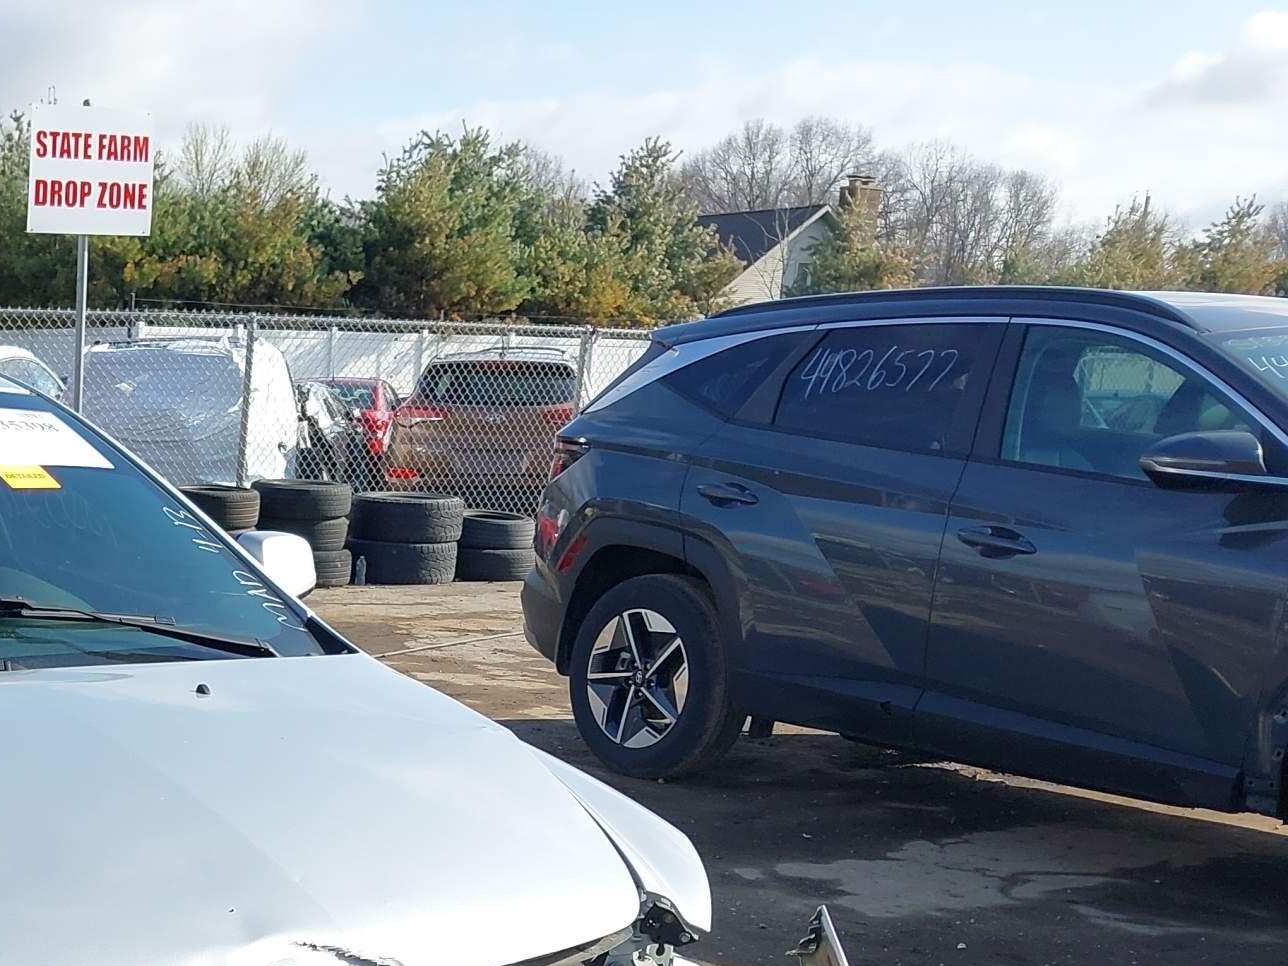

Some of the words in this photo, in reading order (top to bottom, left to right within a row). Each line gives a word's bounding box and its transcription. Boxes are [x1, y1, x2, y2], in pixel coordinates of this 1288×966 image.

[35, 130, 93, 160] STATE
[97, 133, 150, 163] FARM
[33, 179, 92, 208] DROP
[96, 181, 148, 210] ZONE
[800, 345, 959, 399] 44826577
